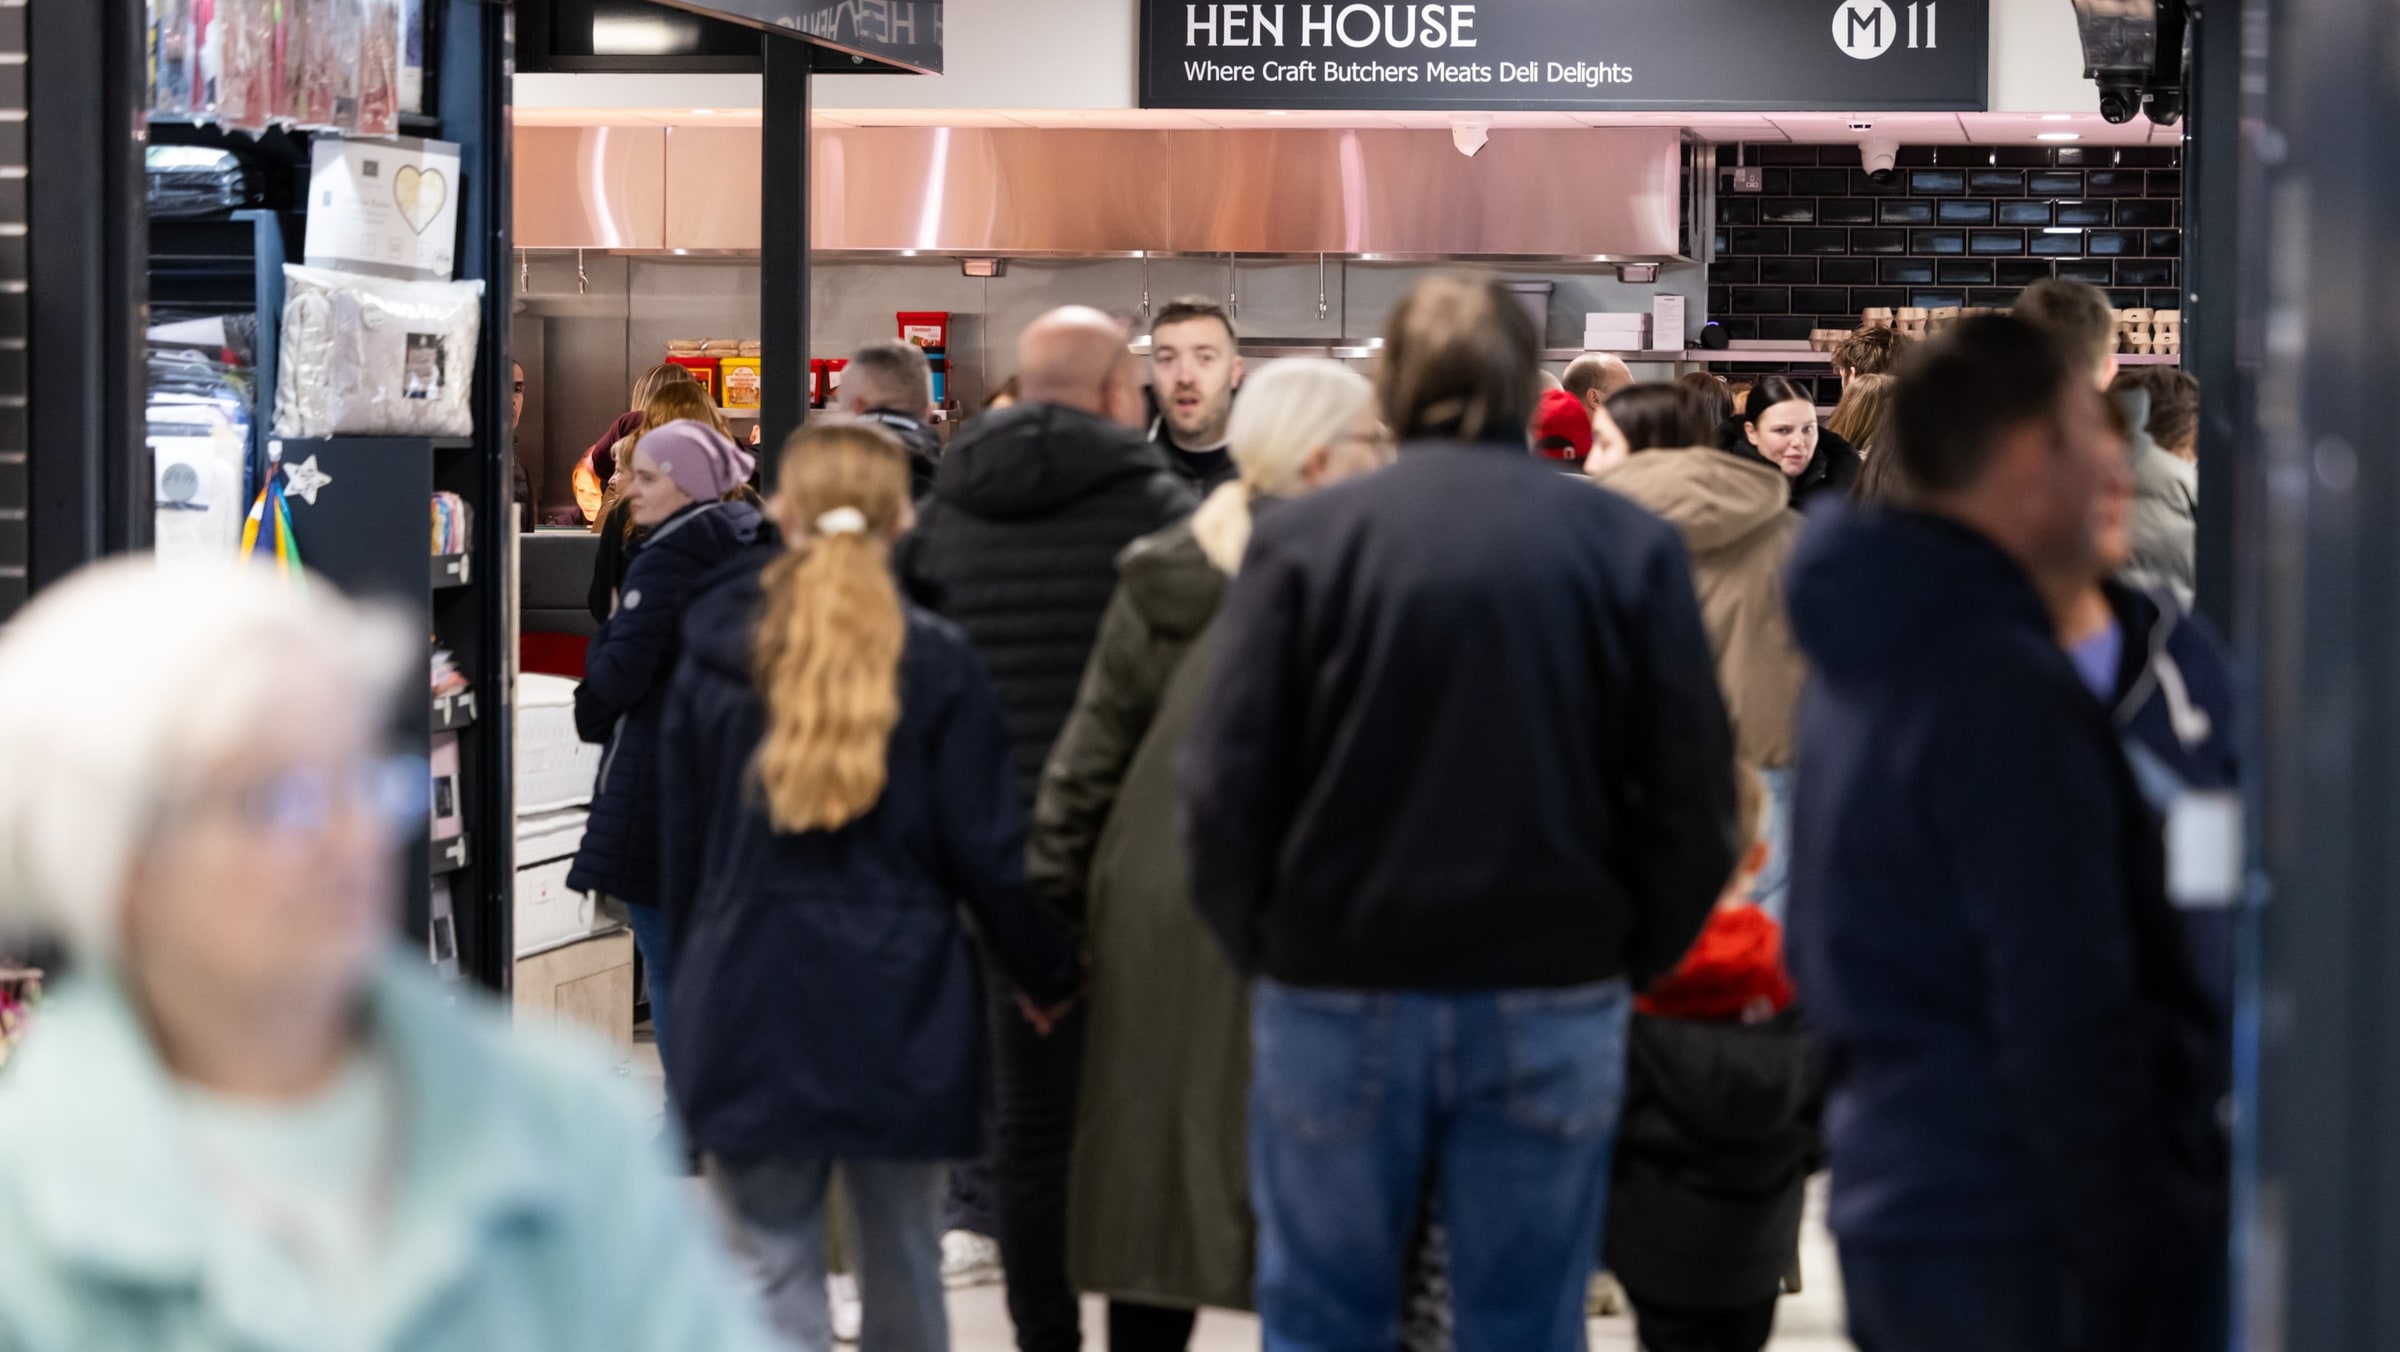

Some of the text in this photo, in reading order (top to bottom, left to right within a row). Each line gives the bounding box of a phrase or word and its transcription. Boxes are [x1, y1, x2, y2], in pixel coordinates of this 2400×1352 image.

[1185, 3, 1478, 48] HEN HOUSE
[1846, 1, 1937, 48] M 11
[1184, 60, 1633, 88] Where Craft Butchers Meats Deli Delights
